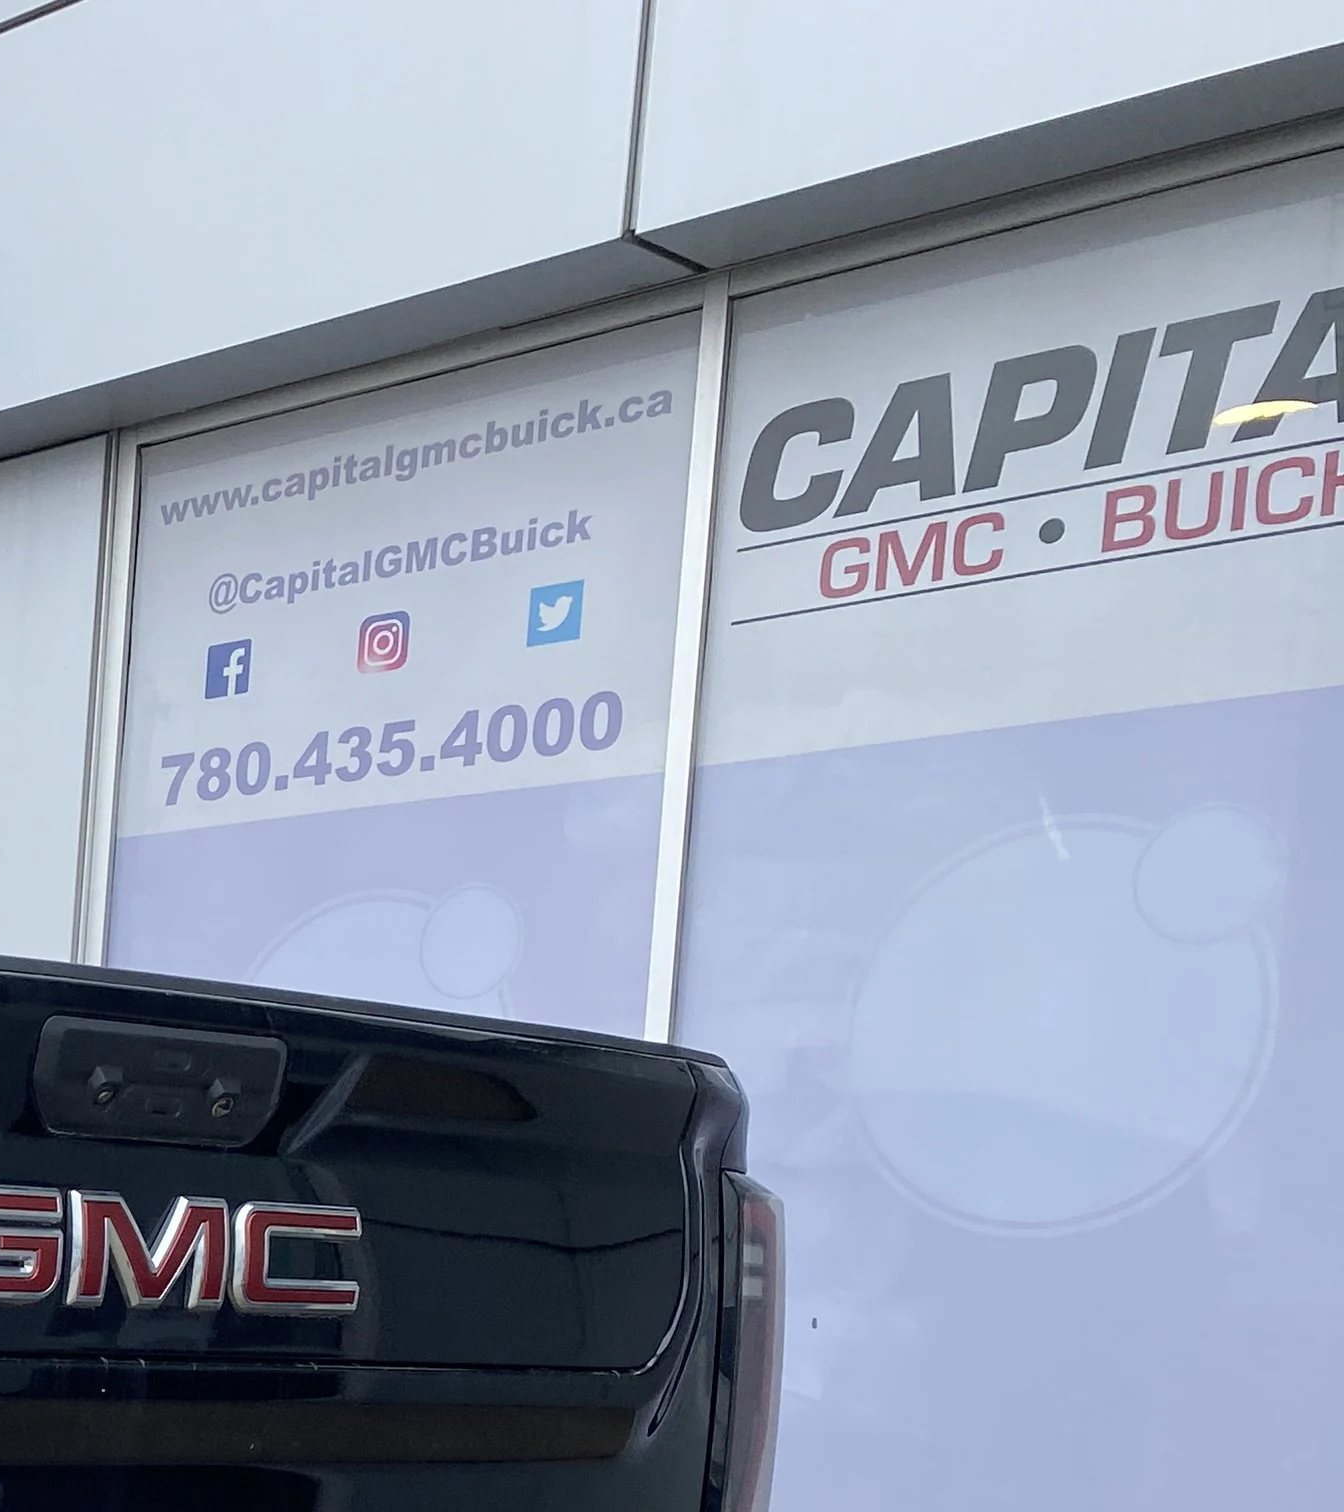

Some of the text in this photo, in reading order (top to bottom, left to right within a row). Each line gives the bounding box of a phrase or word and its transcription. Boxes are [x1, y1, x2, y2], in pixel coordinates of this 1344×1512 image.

[160, 389, 673, 526] www.capitalgmcbuick.ca
[209, 509, 592, 614] @CapitalGMCBuick
[819, 512, 1005, 599] GMC
[160, 690, 623, 806] 780.435.4000
